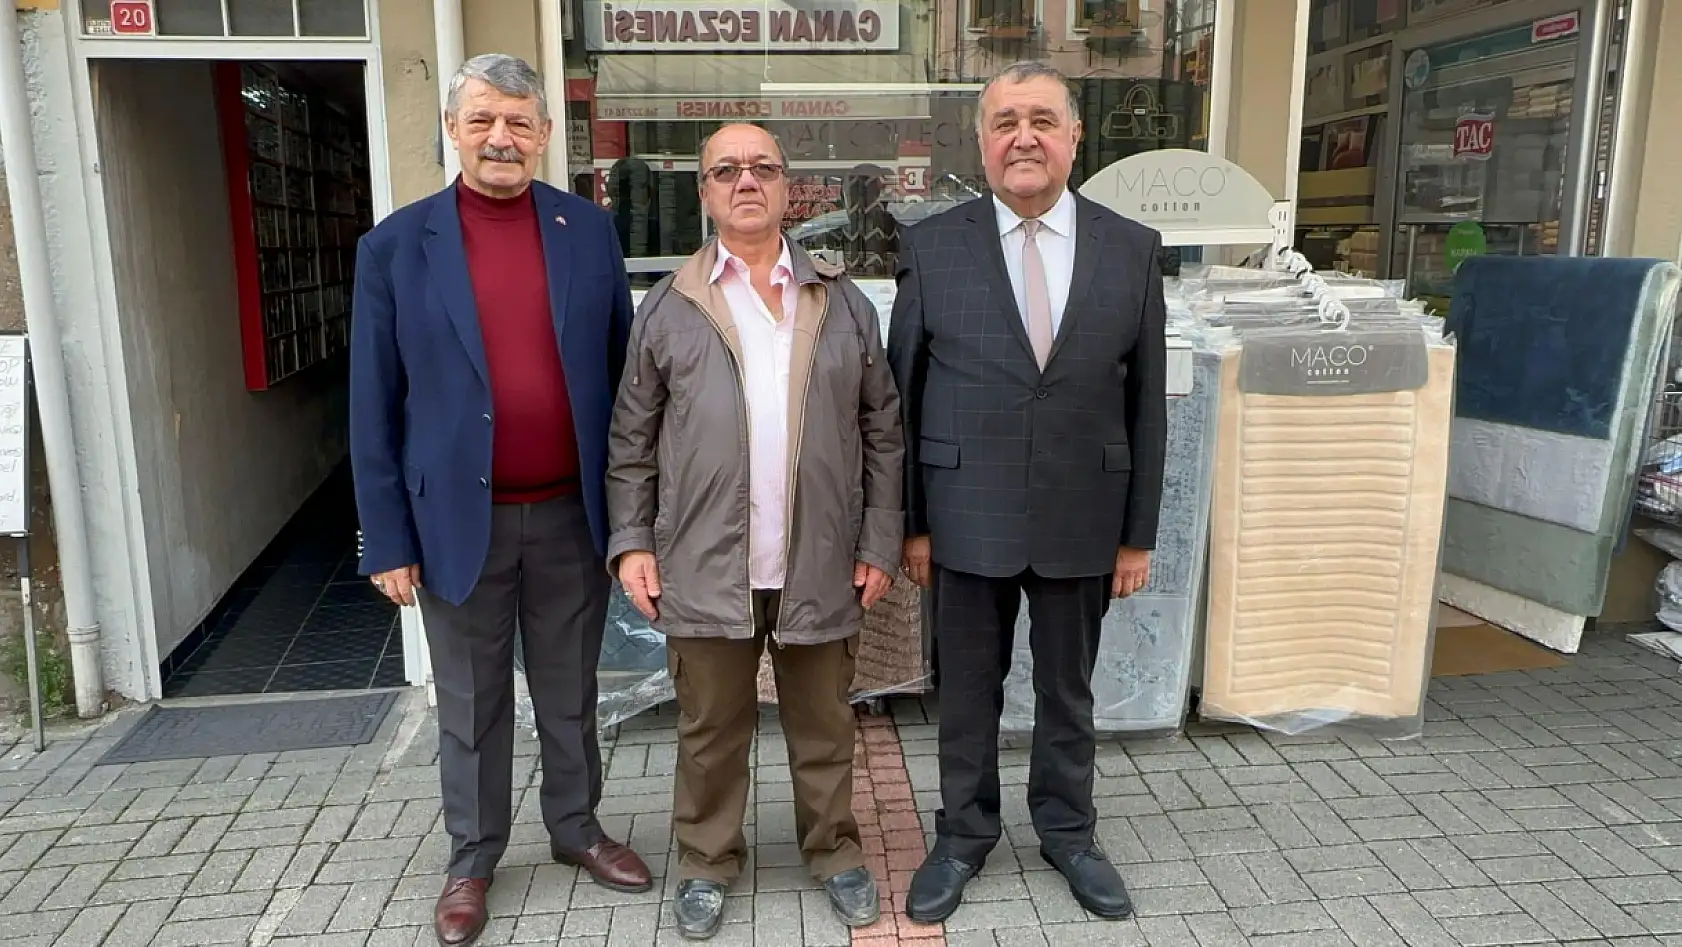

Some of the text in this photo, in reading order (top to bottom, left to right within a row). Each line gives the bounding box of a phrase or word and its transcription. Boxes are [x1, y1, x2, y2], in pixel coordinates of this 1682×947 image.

[119, 8, 145, 26] 20
[1456, 122, 1492, 153] TAÇ
[1115, 166, 1226, 198] MACO
[1141, 202, 1200, 212] cotton
[1290, 344, 1367, 368] MACO
